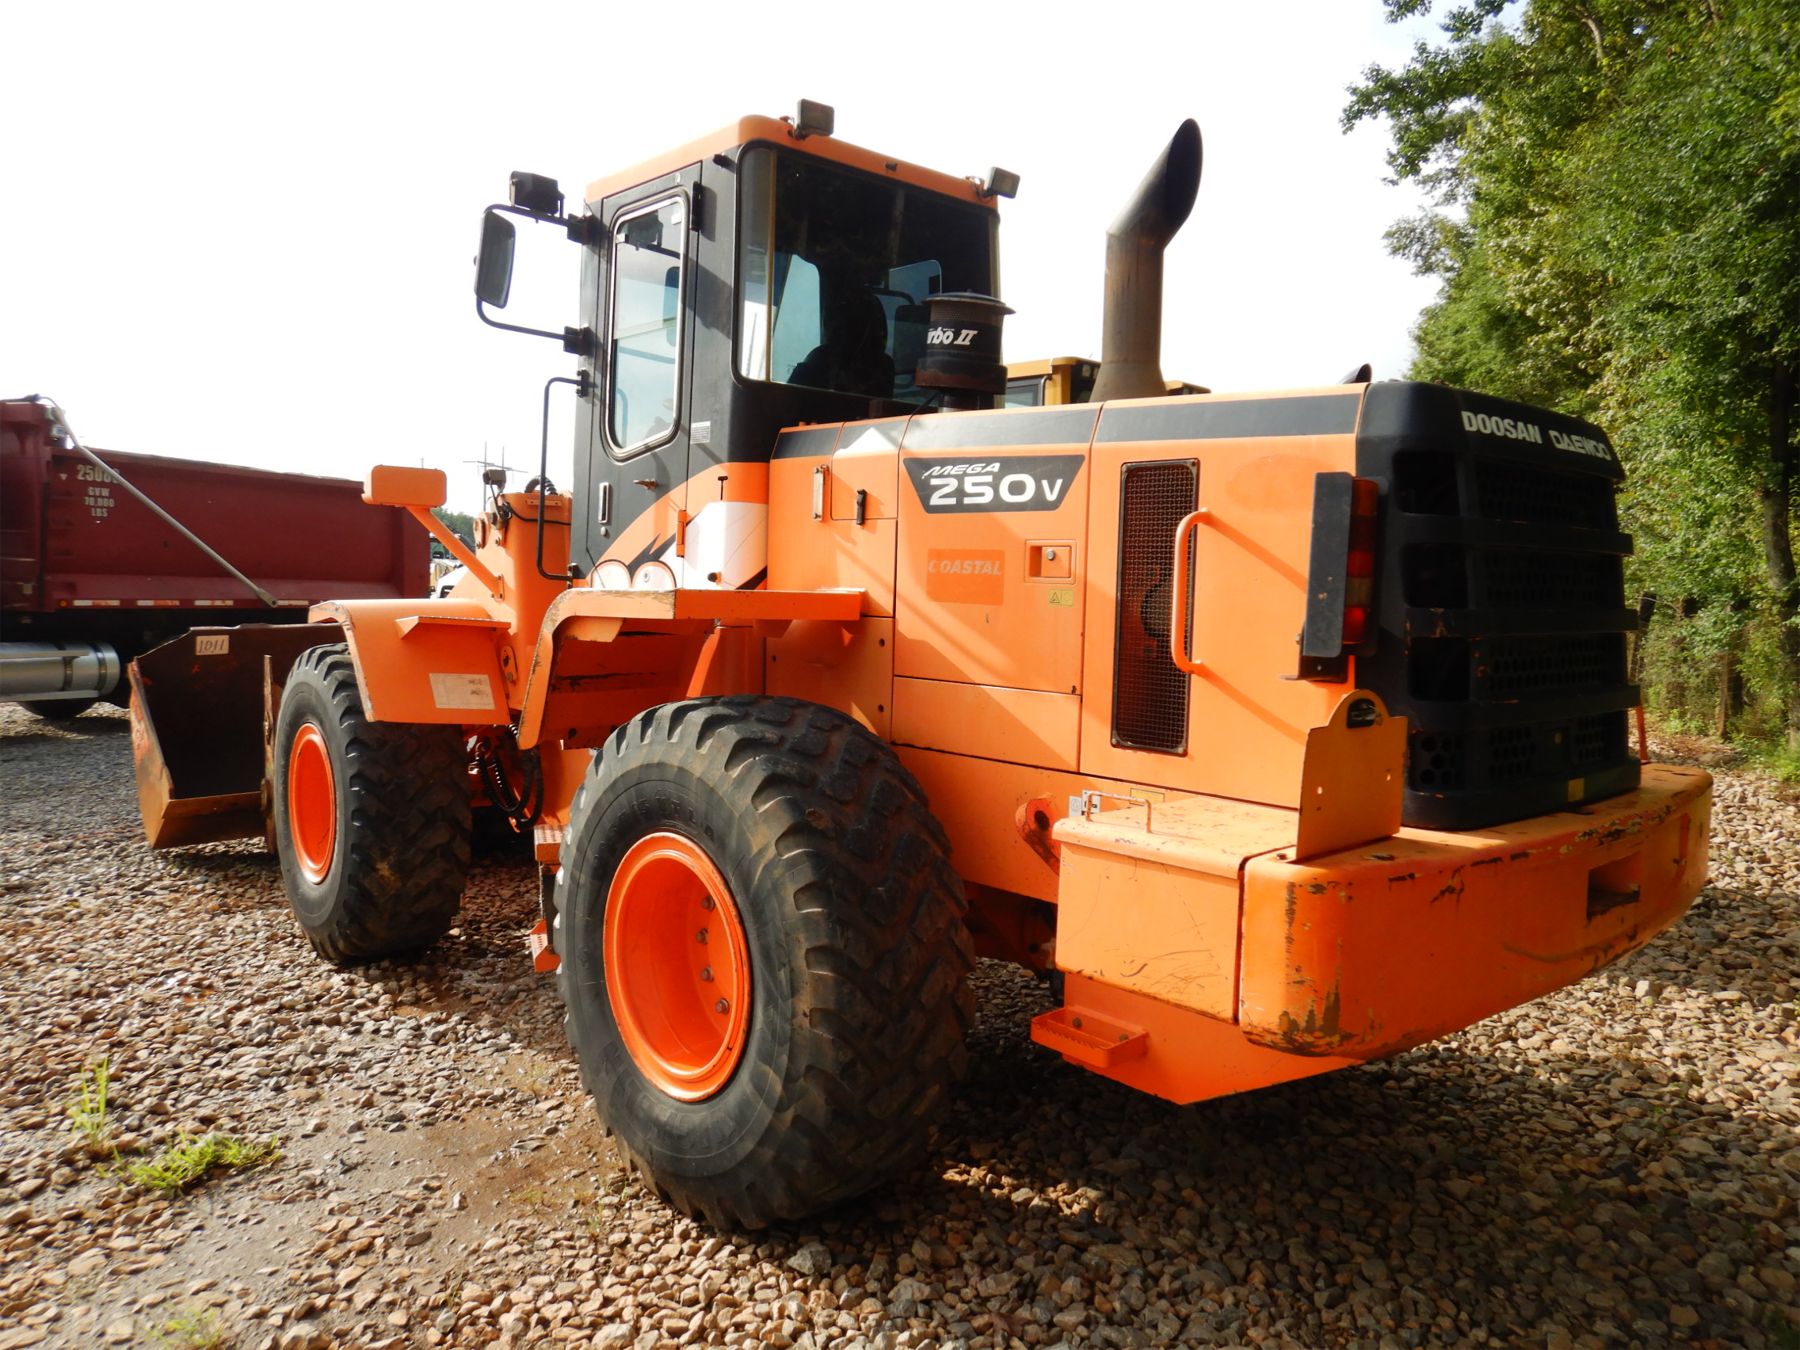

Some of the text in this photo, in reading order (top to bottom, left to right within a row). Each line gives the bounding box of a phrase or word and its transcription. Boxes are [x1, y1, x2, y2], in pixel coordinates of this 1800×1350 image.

[1461, 411, 1611, 461] DOOSAN DAEWOO
[922, 462, 1000, 479] MEGA
[91, 507, 108, 517] LBS
[928, 559, 1002, 576] COASTAL
